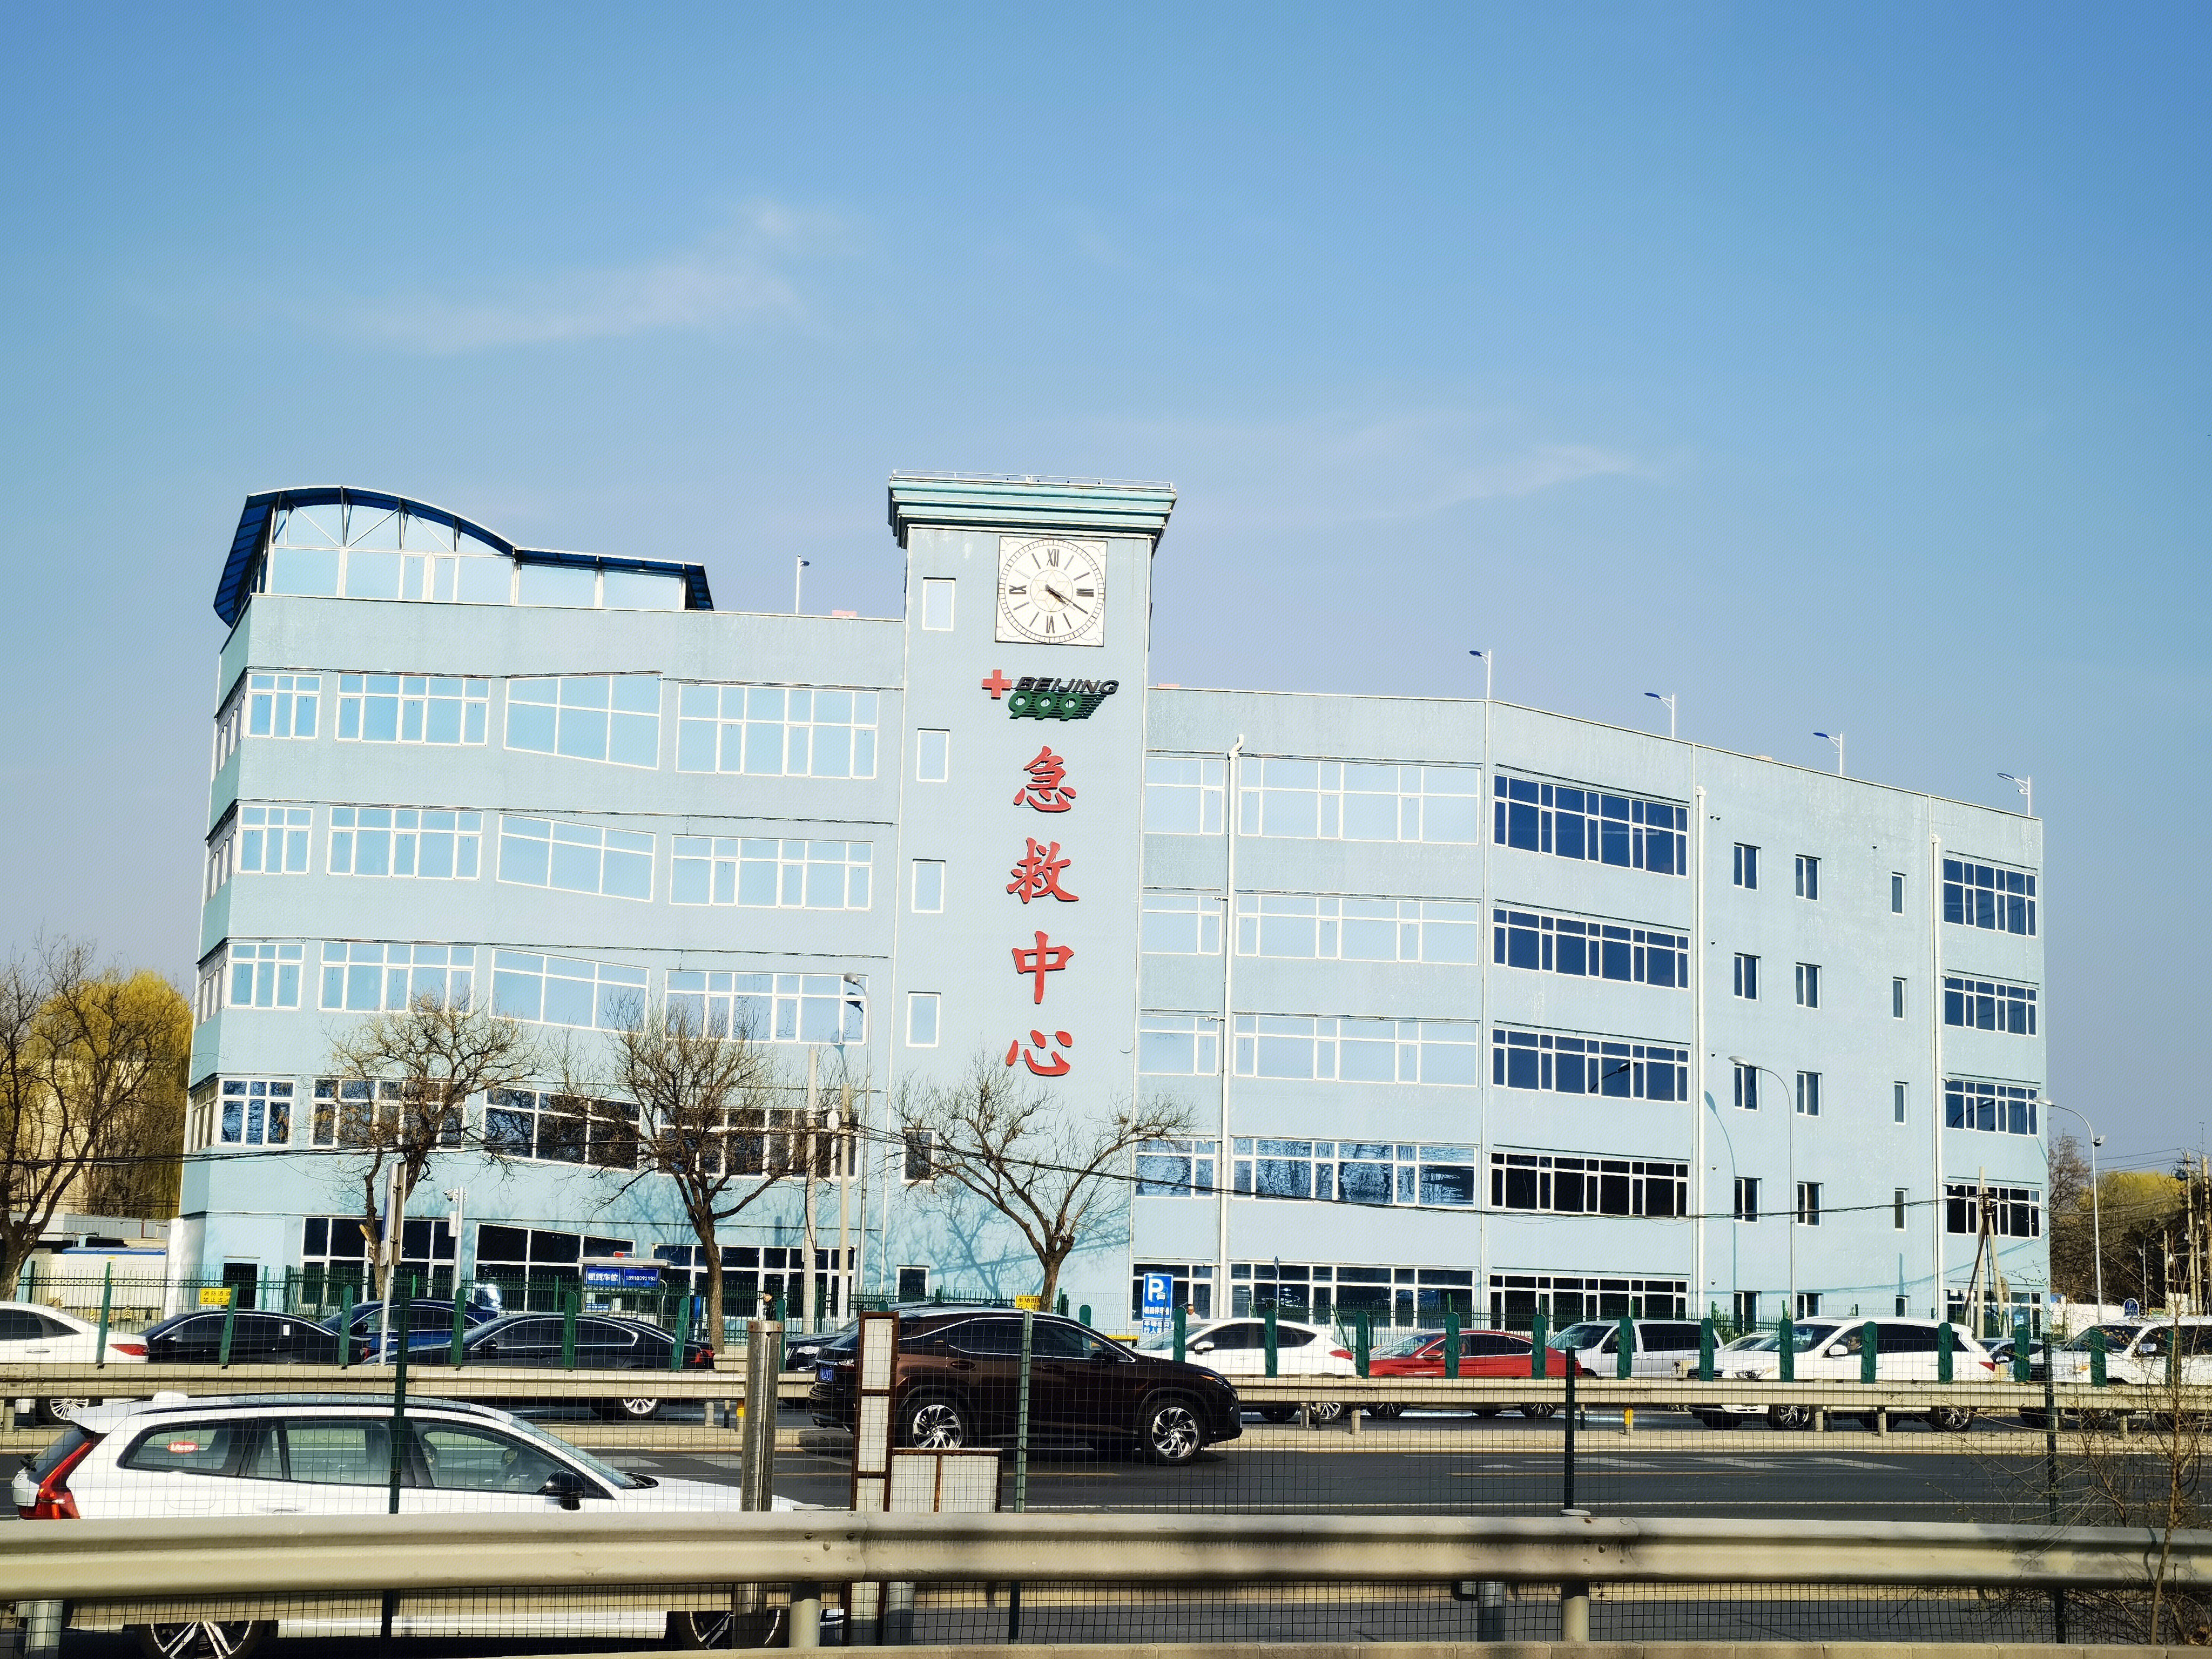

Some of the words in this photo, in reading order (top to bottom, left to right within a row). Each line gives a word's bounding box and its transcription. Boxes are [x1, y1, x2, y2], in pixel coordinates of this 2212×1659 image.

[1015, 677, 1120, 694] BEIJING
[1008, 690, 1083, 721] 999
[1006, 745, 1080, 1077] 急救中心
[1148, 1278, 1164, 1302] P
